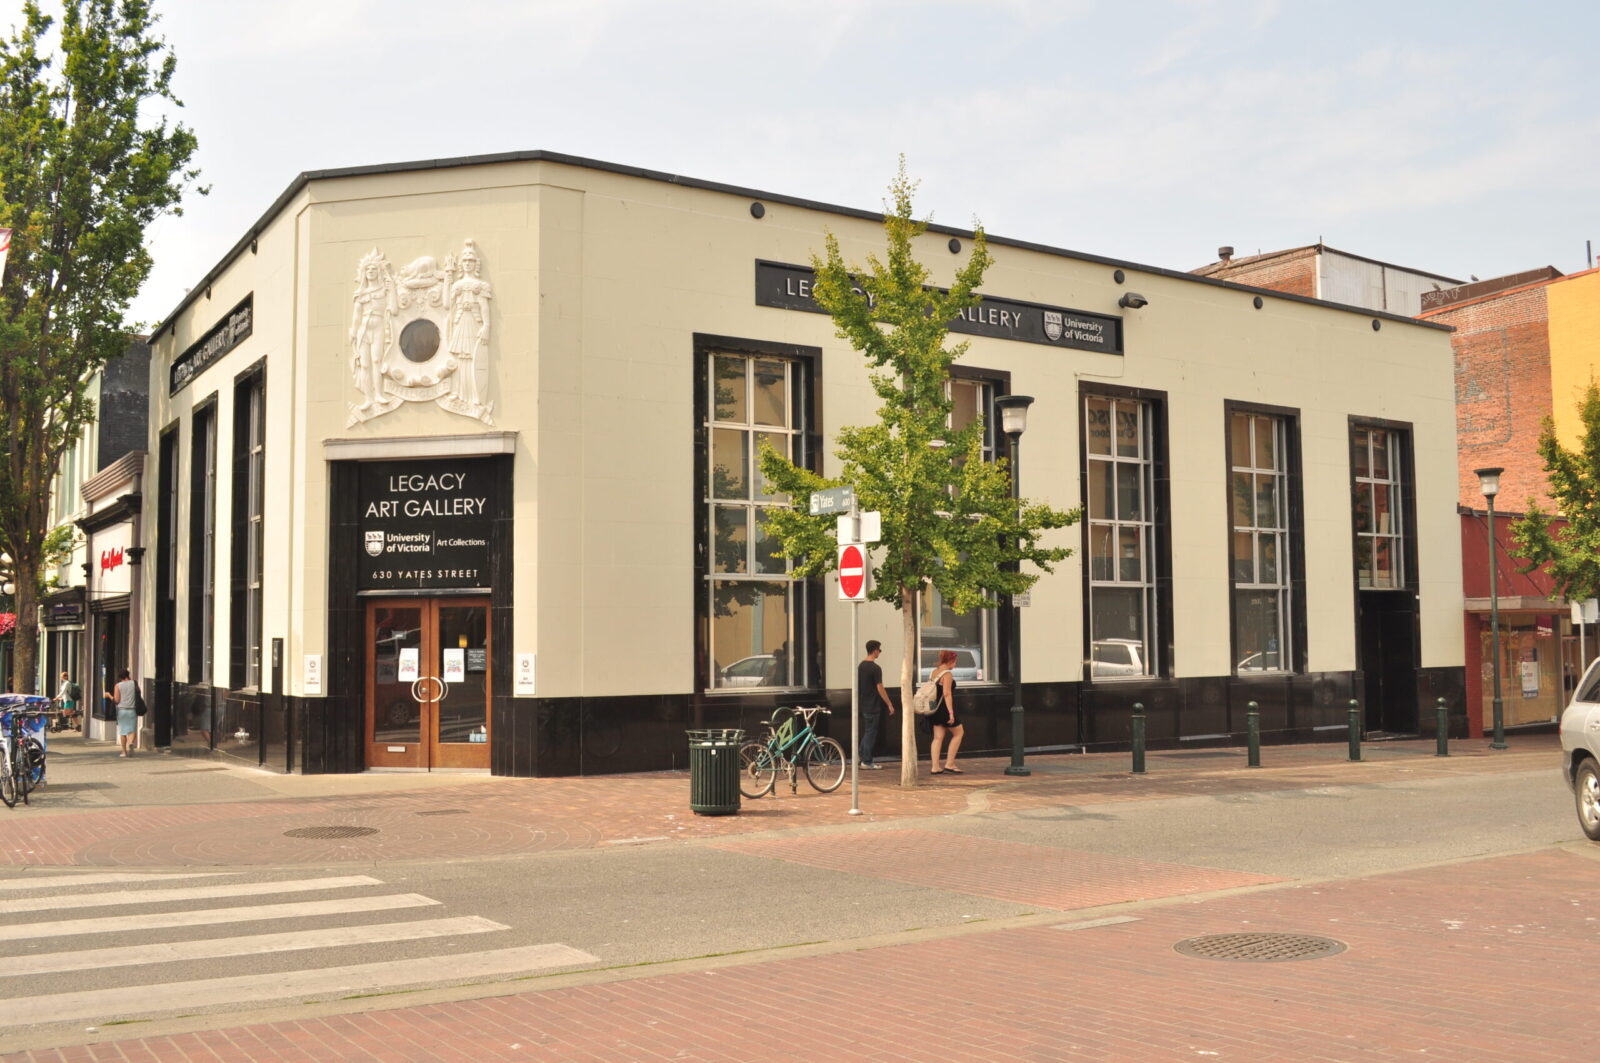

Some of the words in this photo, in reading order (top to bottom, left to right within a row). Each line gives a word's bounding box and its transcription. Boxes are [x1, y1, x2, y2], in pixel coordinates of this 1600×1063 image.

[953, 306, 1022, 329] ALLERY
[1065, 317, 1103, 335] University
[1064, 330, 1073, 339] of
[1074, 332, 1104, 344] Victoria
[390, 473, 466, 492] LEGACY
[365, 501, 399, 518] ART
[404, 498, 486, 517] GALLERY
[820, 495, 834, 509] Yates
[386, 533, 430, 543] University
[436, 539, 447, 547] Art
[448, 538, 486, 547] Collections
[386, 544, 396, 553] of
[397, 543, 430, 553] Victoria
[372, 571, 393, 579] 630
[398, 570, 433, 579] YATES
[438, 569, 478, 579] STREET
